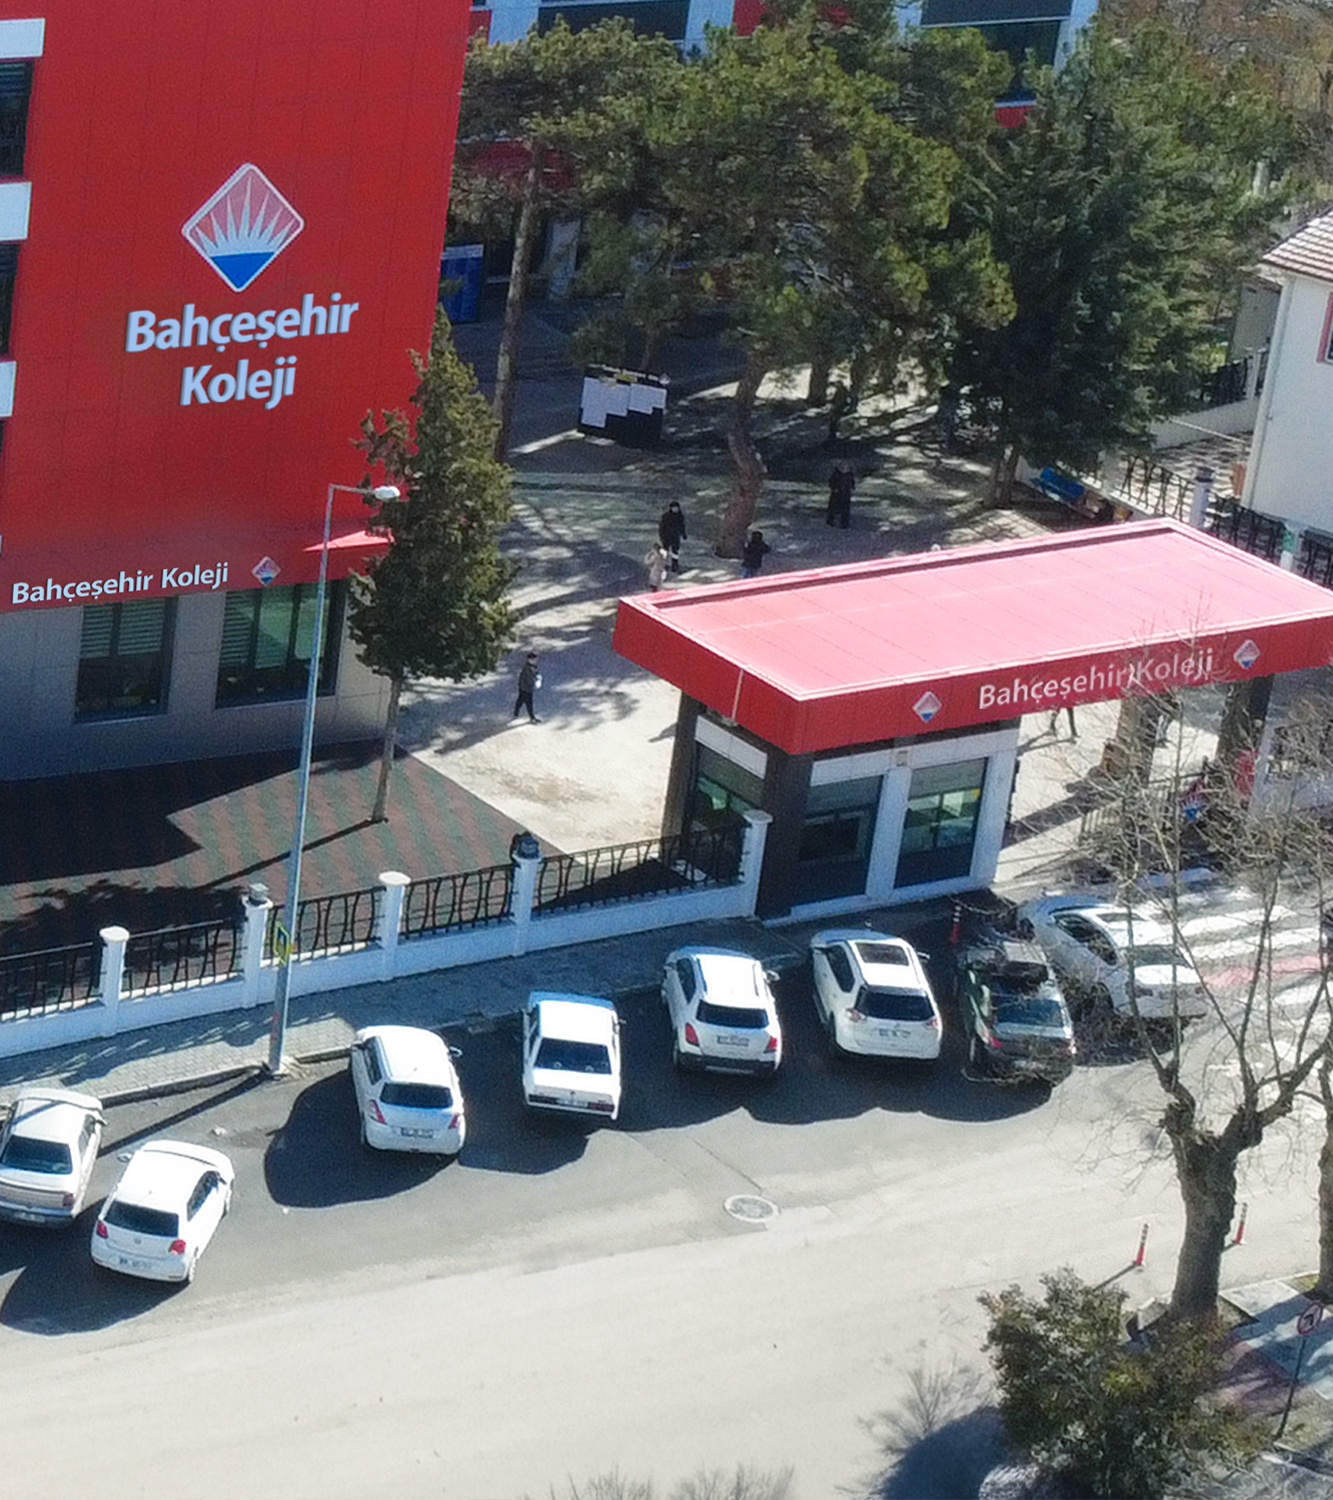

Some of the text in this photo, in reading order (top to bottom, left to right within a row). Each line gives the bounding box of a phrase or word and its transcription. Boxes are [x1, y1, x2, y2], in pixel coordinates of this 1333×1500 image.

[125, 292, 359, 353] Bahçeşehir
[180, 355, 298, 409] Koleji
[11, 562, 229, 604] Bahçeşehir Koleji
[979, 647, 1213, 709] Bahçeşehir Koleji
